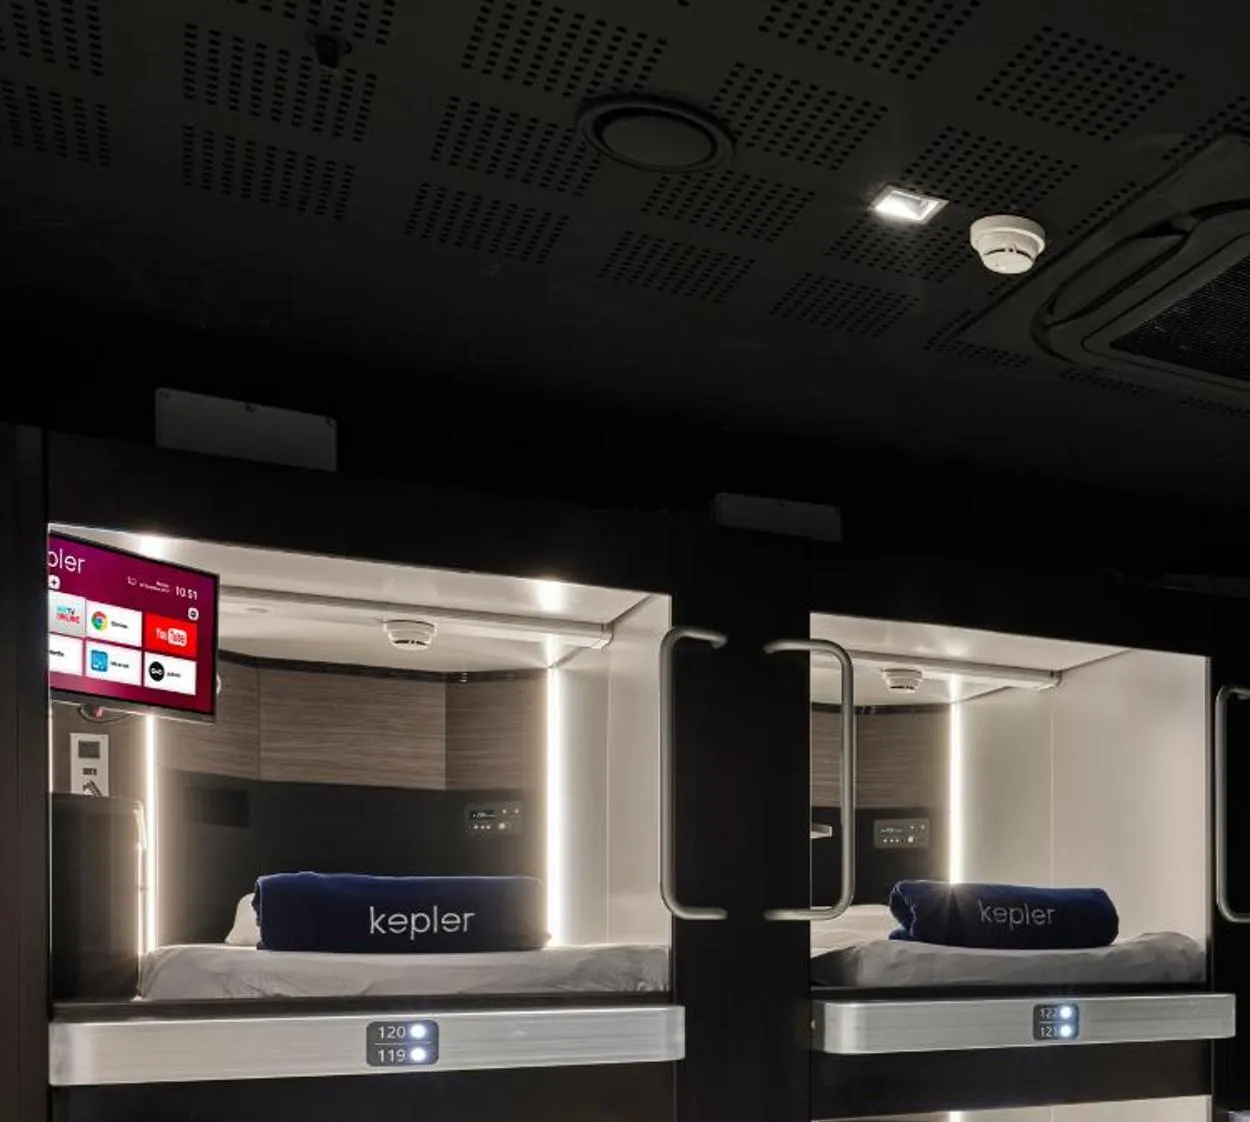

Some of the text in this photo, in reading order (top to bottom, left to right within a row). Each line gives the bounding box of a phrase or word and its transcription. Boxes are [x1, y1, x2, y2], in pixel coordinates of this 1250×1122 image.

[369, 906, 477, 940] kepler
[978, 898, 1056, 931] kepler
[378, 1026, 406, 1039] 120
[378, 1049, 406, 1062] 119
